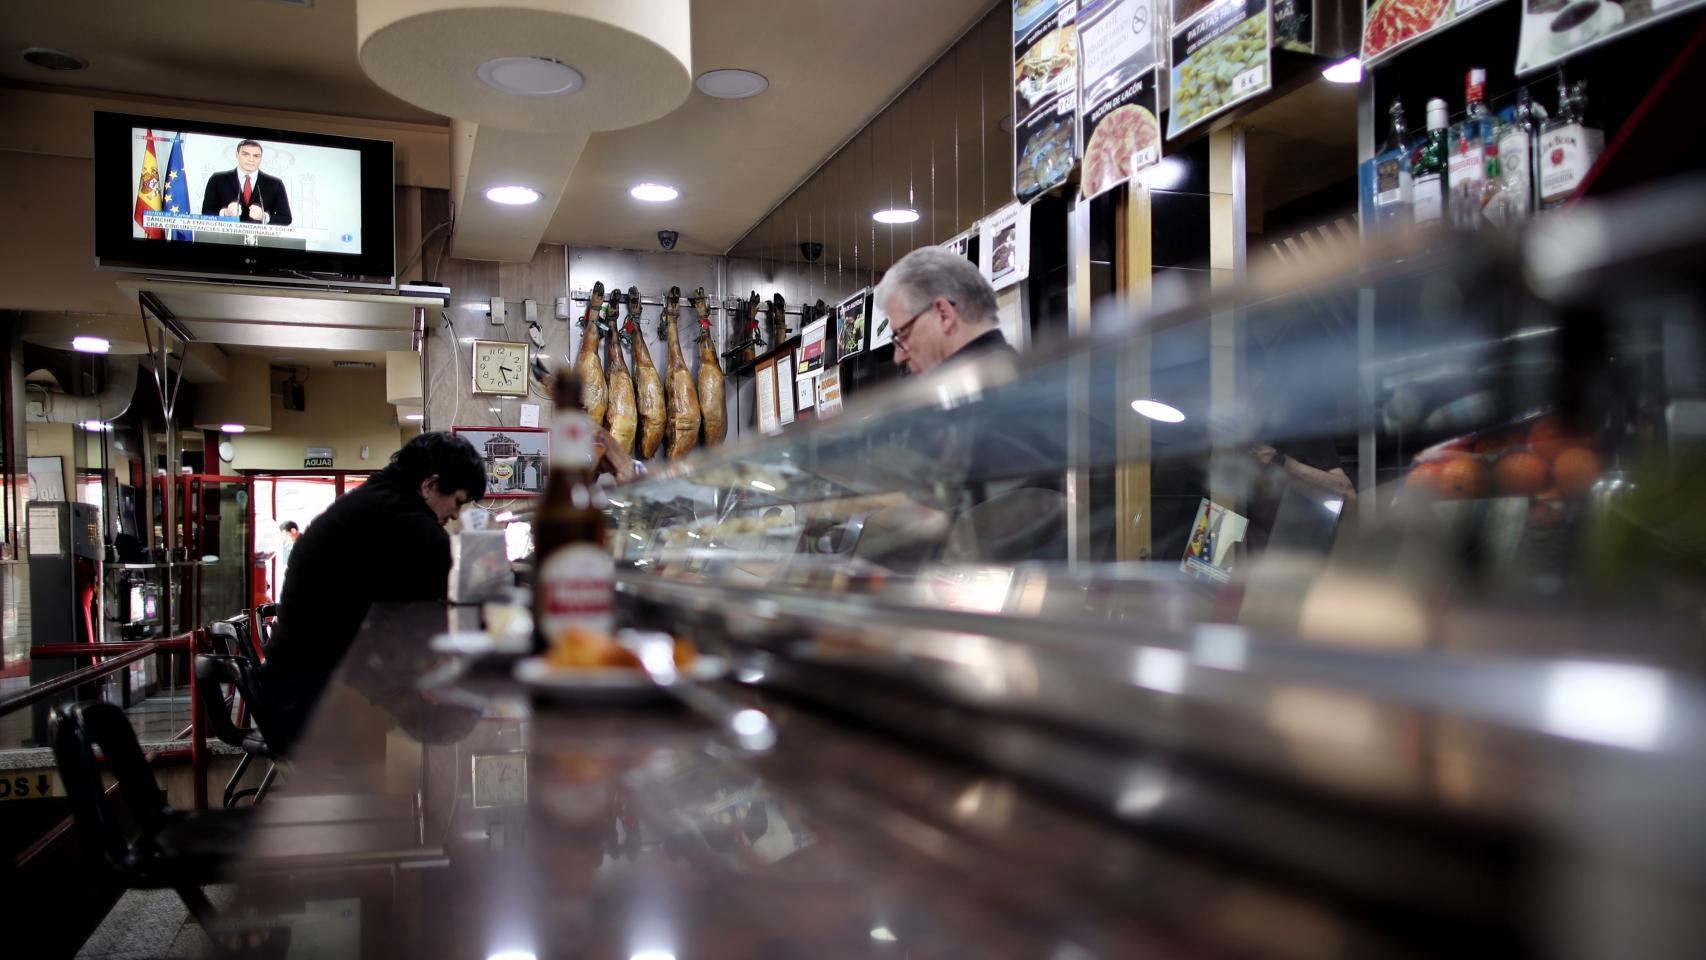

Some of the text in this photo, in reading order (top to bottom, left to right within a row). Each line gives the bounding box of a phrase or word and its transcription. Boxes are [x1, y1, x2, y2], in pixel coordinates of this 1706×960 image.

[1187, 9, 1222, 41] PATATAS
[1112, 95, 1121, 108] DE
[1121, 80, 1143, 102] LACÓN
[192, 219, 233, 228] EMERGENCIA
[234, 222, 268, 231] SANITARIA
